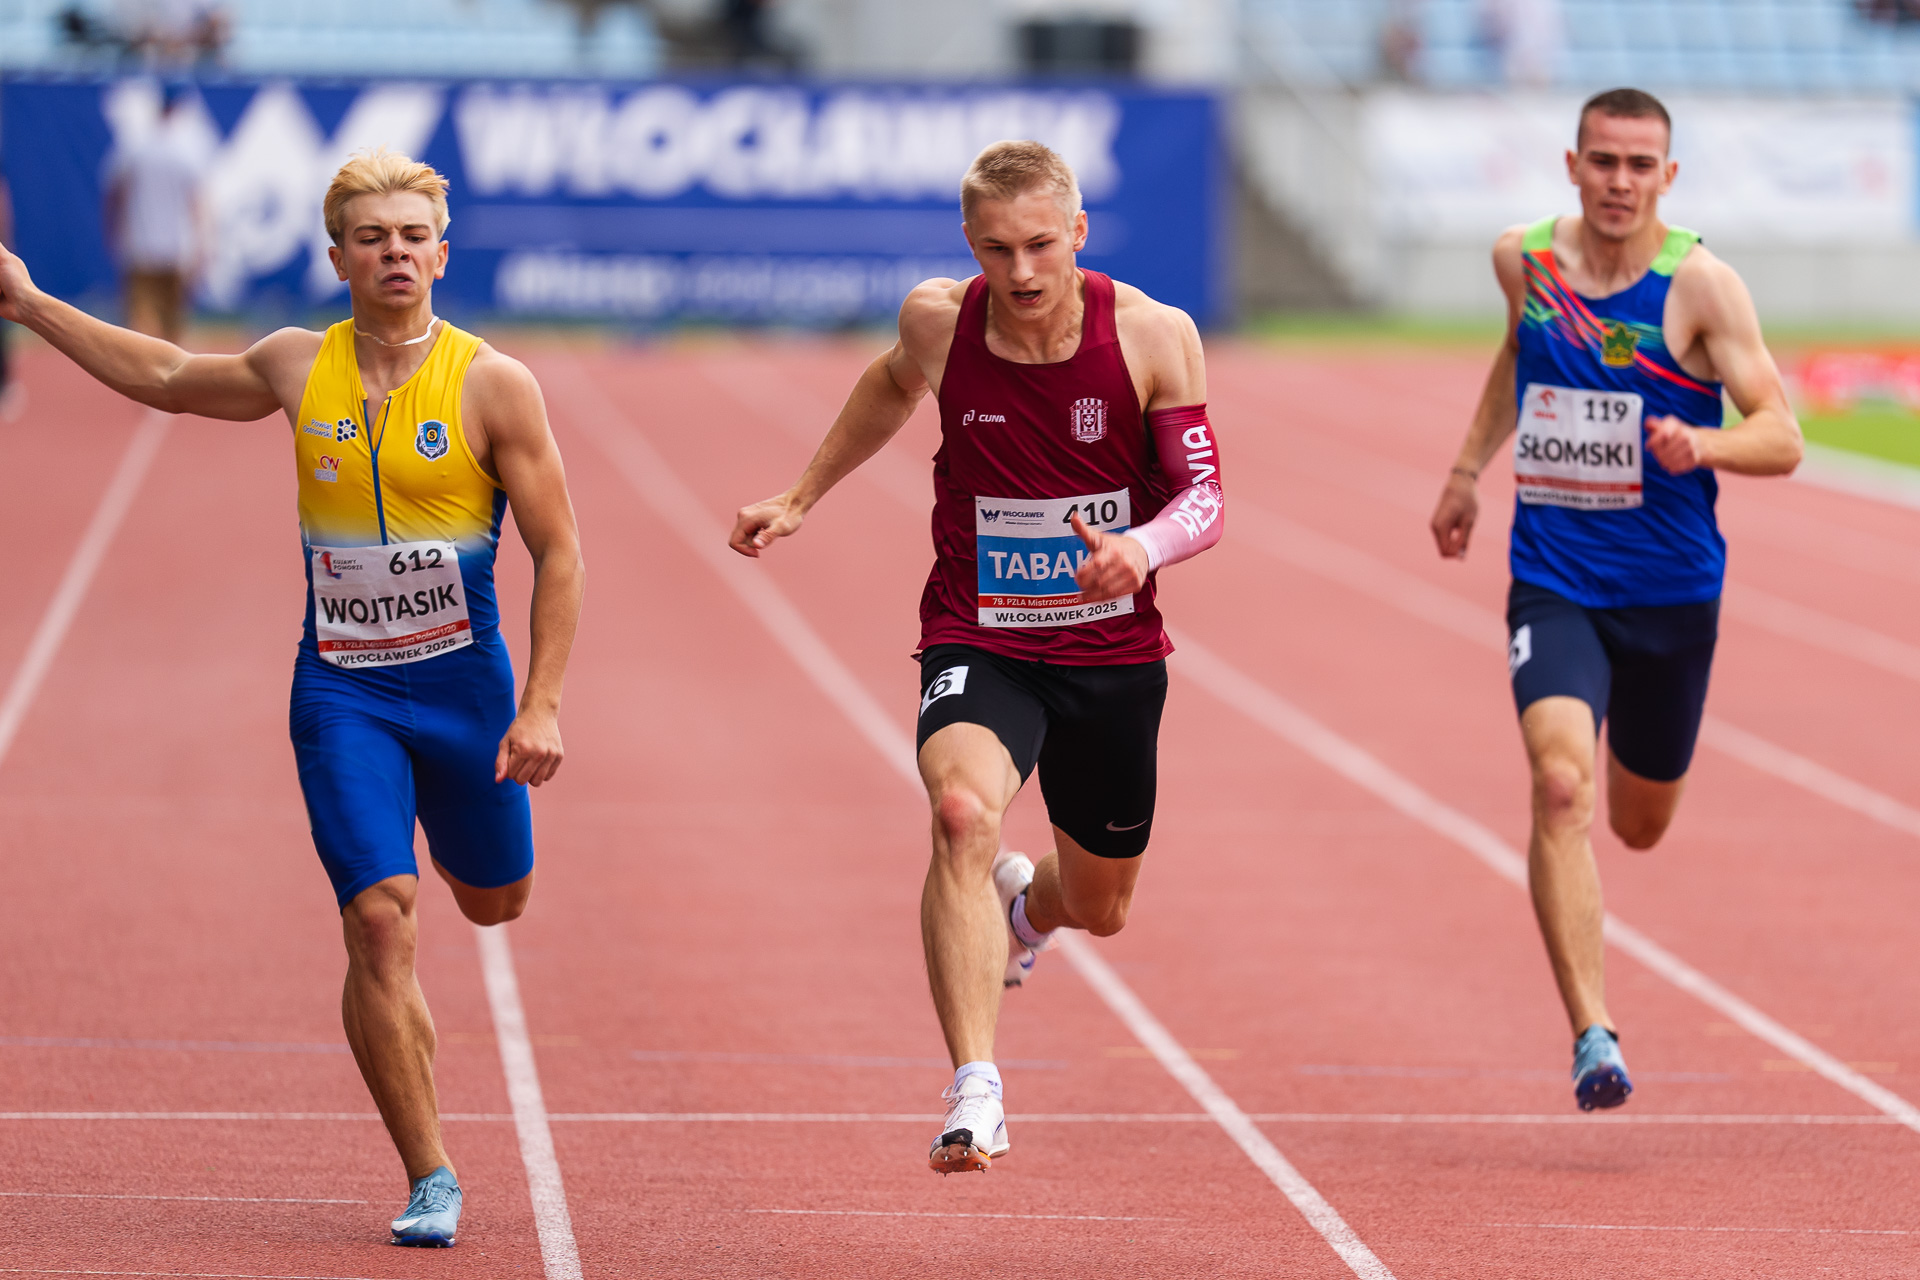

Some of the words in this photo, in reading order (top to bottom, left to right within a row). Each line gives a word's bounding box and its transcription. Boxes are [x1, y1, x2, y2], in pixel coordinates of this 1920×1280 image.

[979, 414, 1006, 423] CUNA
[1585, 398, 1629, 423] 119
[1518, 433, 1633, 467] SŁOMSKI
[1062, 500, 1118, 526] 410
[389, 548, 445, 575] 612
[320, 583, 459, 624] WOJTASIK
[993, 597, 1005, 606] 79.
[1007, 598, 1026, 606] PZLA
[995, 609, 1085, 623] WŁOCŁAWEK
[1087, 601, 1118, 617] 2025
[332, 641, 344, 649] 79.
[345, 641, 364, 649] PZLA
[365, 637, 415, 648] Mistrzostwa
[416, 629, 440, 641] Polski
[441, 624, 457, 635] U20
[336, 647, 422, 665] WŁOCŁAWEK
[425, 638, 456, 654] 2025
[928, 671, 954, 700] 6
